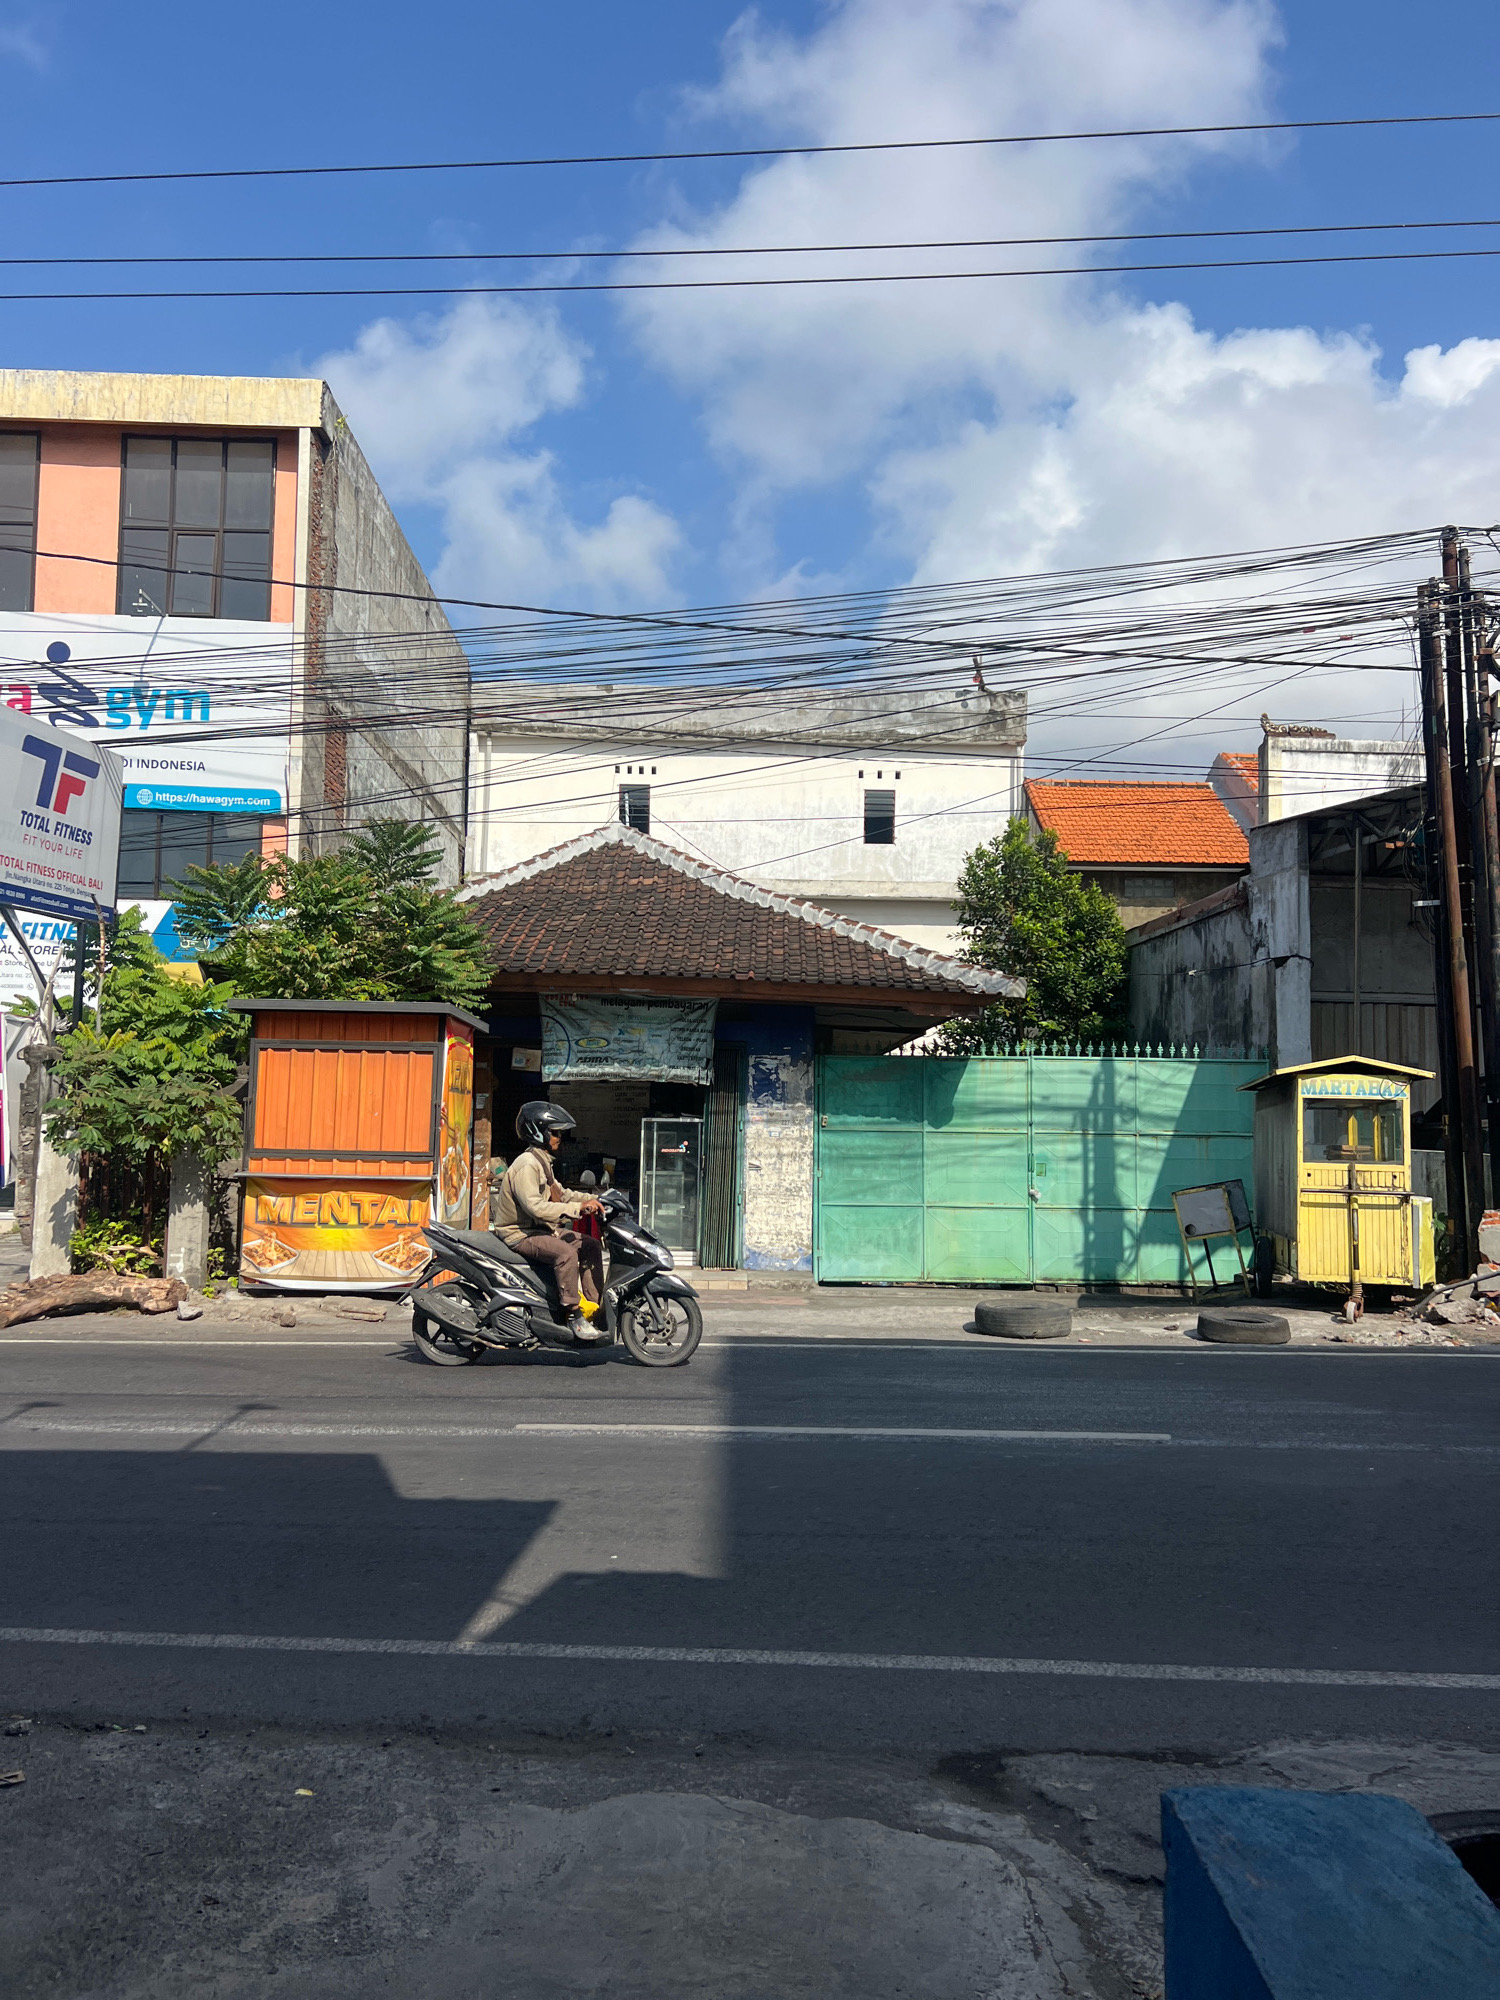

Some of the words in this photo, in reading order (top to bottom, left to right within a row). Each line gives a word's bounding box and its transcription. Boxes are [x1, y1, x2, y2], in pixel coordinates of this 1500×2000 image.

[105, 688, 210, 731] gym
[136, 758, 206, 771] INDONESIA
[155, 791, 271, 807] https://hawagym.com
[20, 810, 50, 834] TOTAL
[53, 821, 93, 846] FITNESS
[23, 833, 38, 846] FIT
[40, 838, 63, 854] YOUR
[65, 846, 84, 860] LIFE
[0, 855, 24, 871] TOTAL
[26, 861, 56, 879] FITNESS
[57, 869, 86, 887] OFFICIAL
[88, 877, 104, 891] BALI
[21, 922, 77, 941] FITNE
[601, 998, 644, 1010] melayani
[647, 998, 709, 1013] pembayaran
[1301, 1079, 1407, 1097] MARTABAK
[255, 1192, 425, 1228] MENTAI
